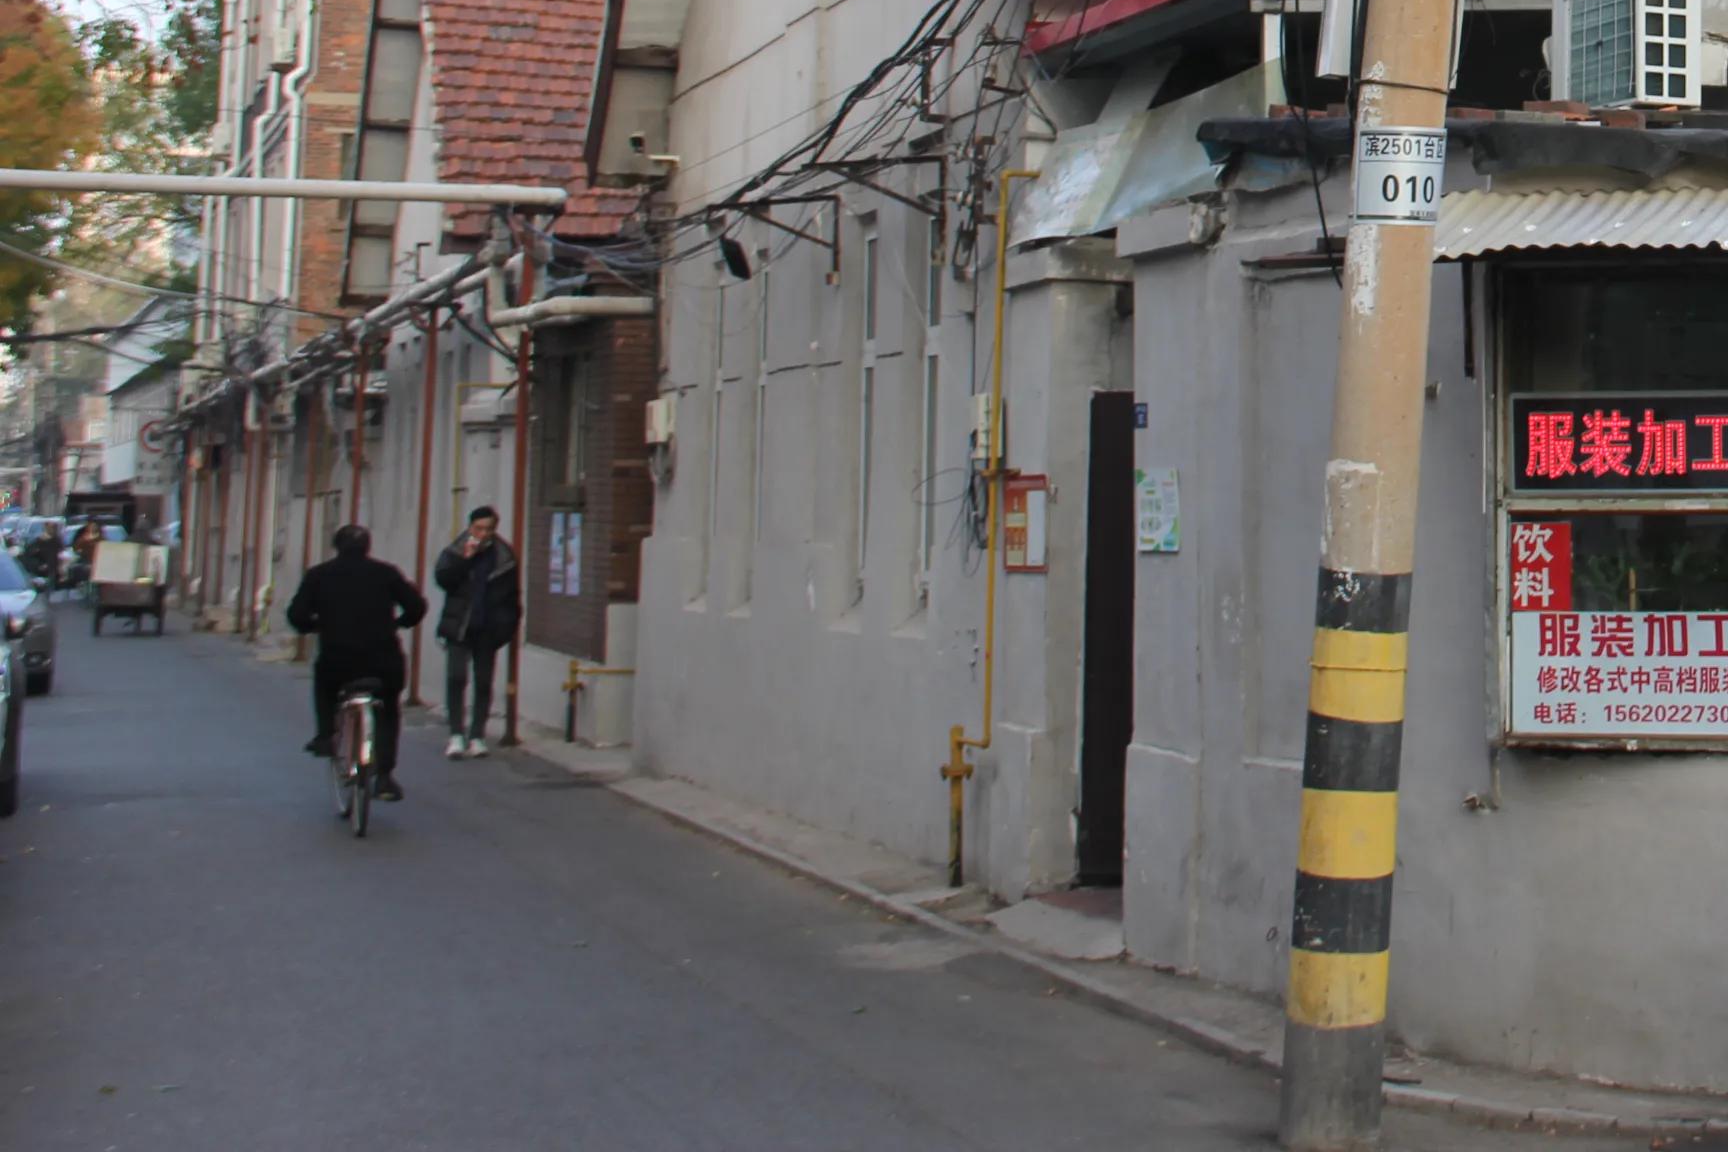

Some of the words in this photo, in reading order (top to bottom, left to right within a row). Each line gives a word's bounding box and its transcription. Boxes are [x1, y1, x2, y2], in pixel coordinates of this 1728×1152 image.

[1382, 174, 1434, 203] 010
[1513, 523, 1554, 608] 饮料
[1533, 702, 1587, 725] 电话：
